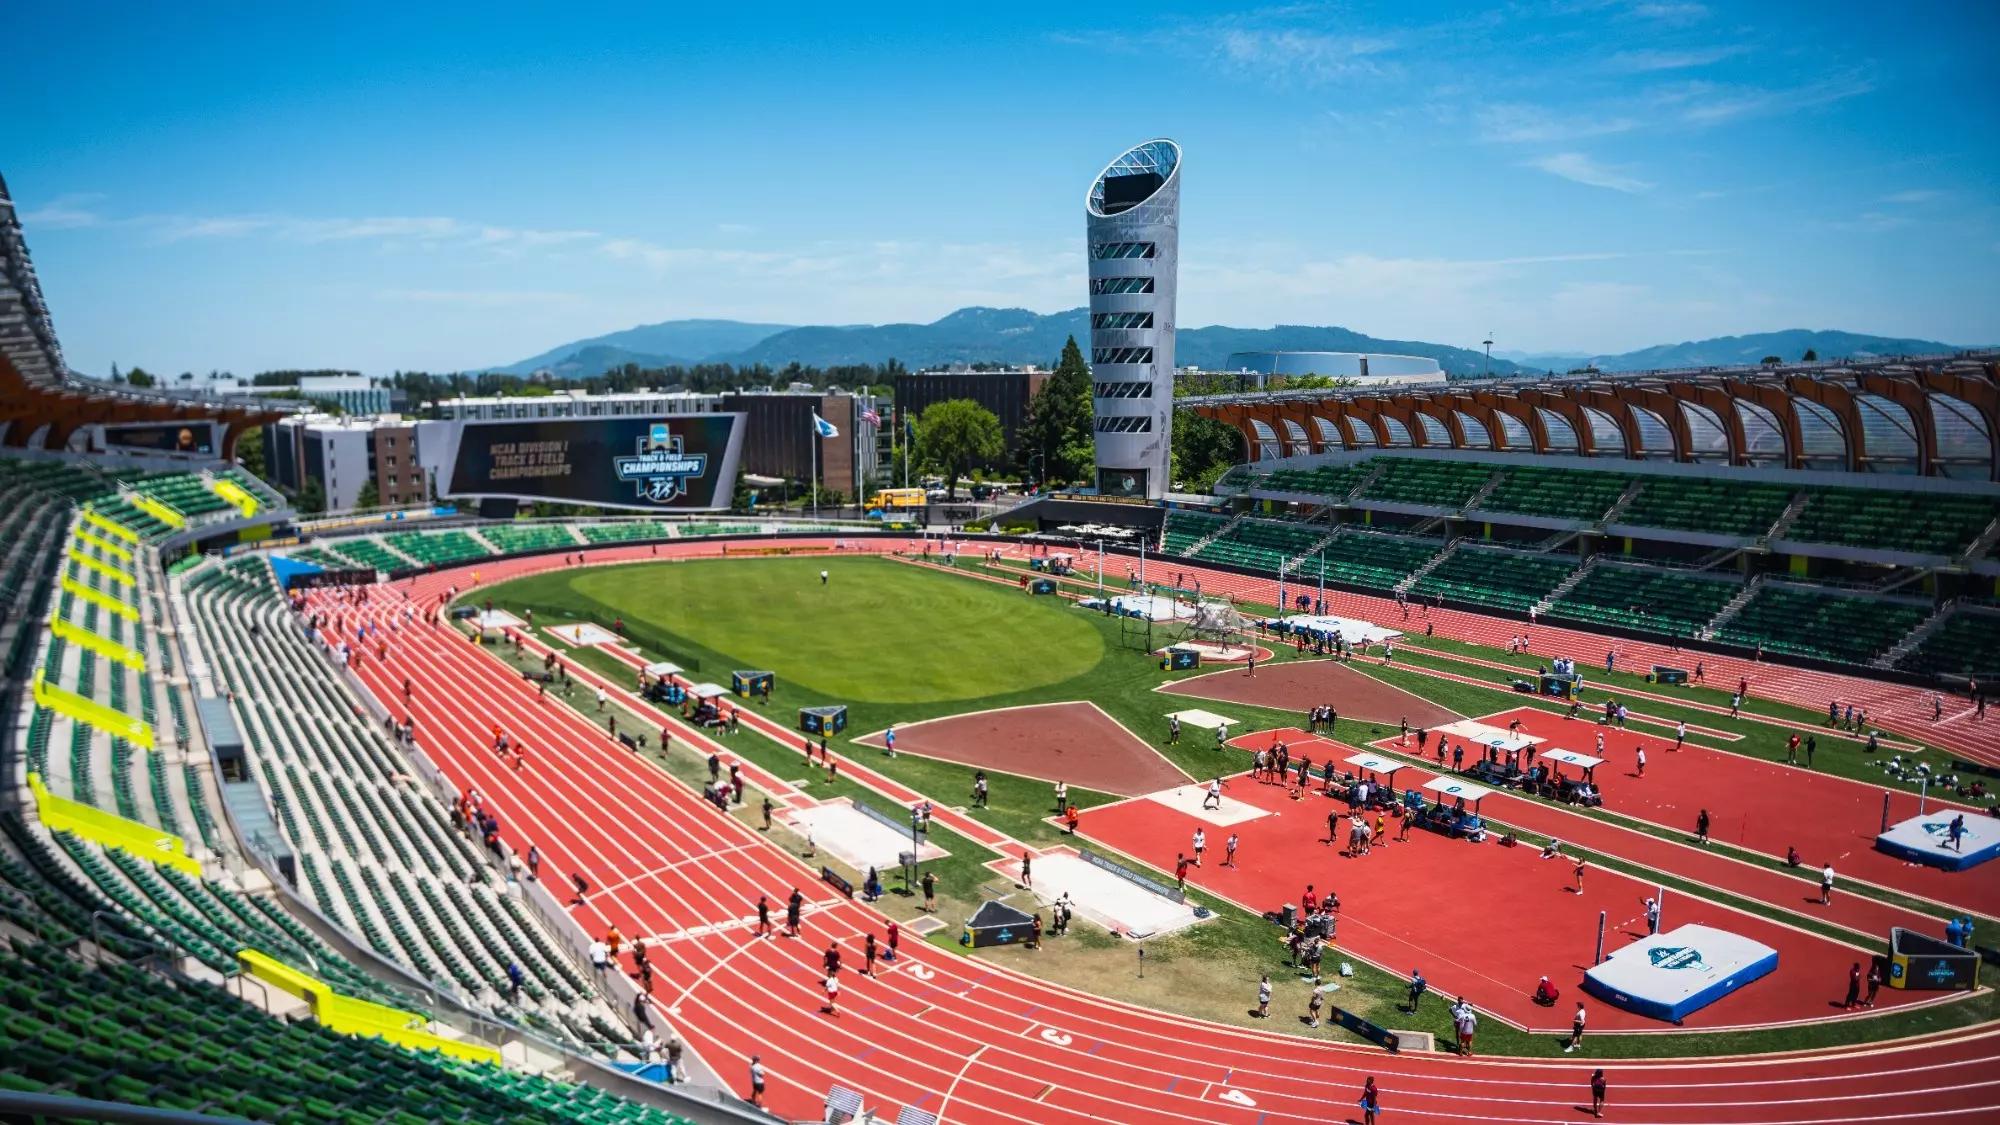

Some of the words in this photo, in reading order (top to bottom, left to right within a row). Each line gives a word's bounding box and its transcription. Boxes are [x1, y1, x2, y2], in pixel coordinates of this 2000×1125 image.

[490, 443, 515, 455] NCAA
[518, 441, 561, 453] DIVISION
[495, 454, 526, 466] TRACK
[538, 452, 565, 464] FIELD
[639, 454, 658, 462] TRACK
[665, 453, 682, 461] FIELD
[489, 463, 572, 479] CHAMPIONSHIPS
[623, 461, 699, 474] CHAMPIONSHIPS
[1120, 867, 1133, 879] FIELD
[906, 963, 936, 981] 2
[1040, 1028, 1073, 1046] 3
[1218, 1089, 1257, 1107] 4
